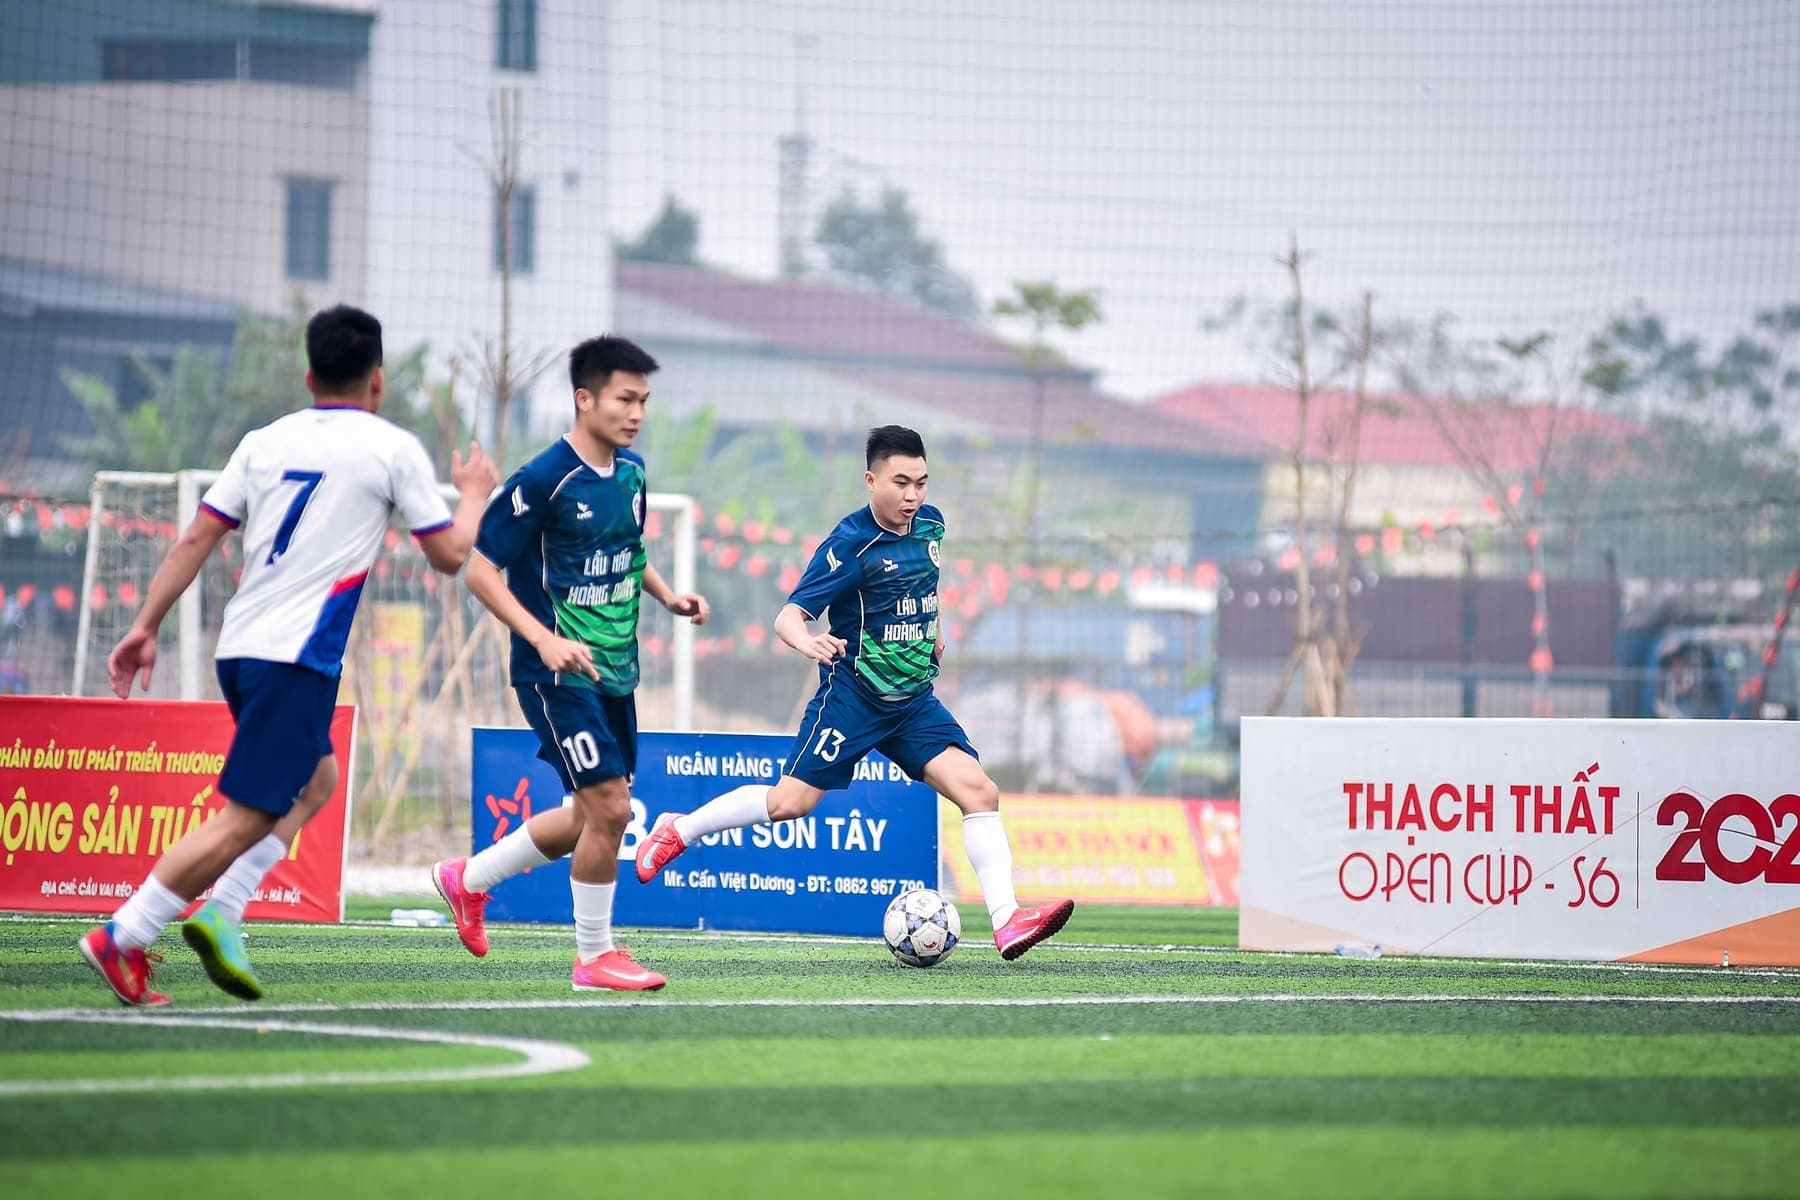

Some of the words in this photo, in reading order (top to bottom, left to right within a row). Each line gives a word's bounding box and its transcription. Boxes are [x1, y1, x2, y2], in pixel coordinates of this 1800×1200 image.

[265, 470, 326, 565] 7
[566, 582, 609, 607] HOÀNG
[884, 621, 924, 641] HOÀNG
[0, 738, 32, 768] HẦN
[33, 739, 65, 770] ĐẦU
[67, 747, 87, 770] TƯ
[86, 745, 123, 771] PHÁT
[126, 741, 163, 773] TRIỂN
[165, 751, 225, 775] THƯƠNG
[561, 731, 601, 773] 10
[813, 727, 847, 762] 13
[666, 752, 717, 776] NGÂN
[721, 753, 772, 778] HÀNG
[1343, 783, 1494, 846] THẠCH
[1510, 761, 1620, 835] THẤT
[0, 787, 73, 866] ỘNG
[78, 785, 143, 856] SẢN
[148, 784, 226, 857] TUẤ
[825, 809, 888, 851] TÂY
[268, 886, 283, 903] HÀ
[664, 870, 685, 887] Mr.
[688, 869, 716, 888] Cấn
[720, 872, 746, 892] Việt
[749, 873, 795, 895] Dương
[807, 875, 831, 893] ĐT:
[834, 877, 867, 894] 0862
[871, 879, 896, 895] 967
[1339, 852, 1451, 903] OPEN
[1463, 854, 1533, 905] CUP
[1568, 856, 1620, 908] S6
